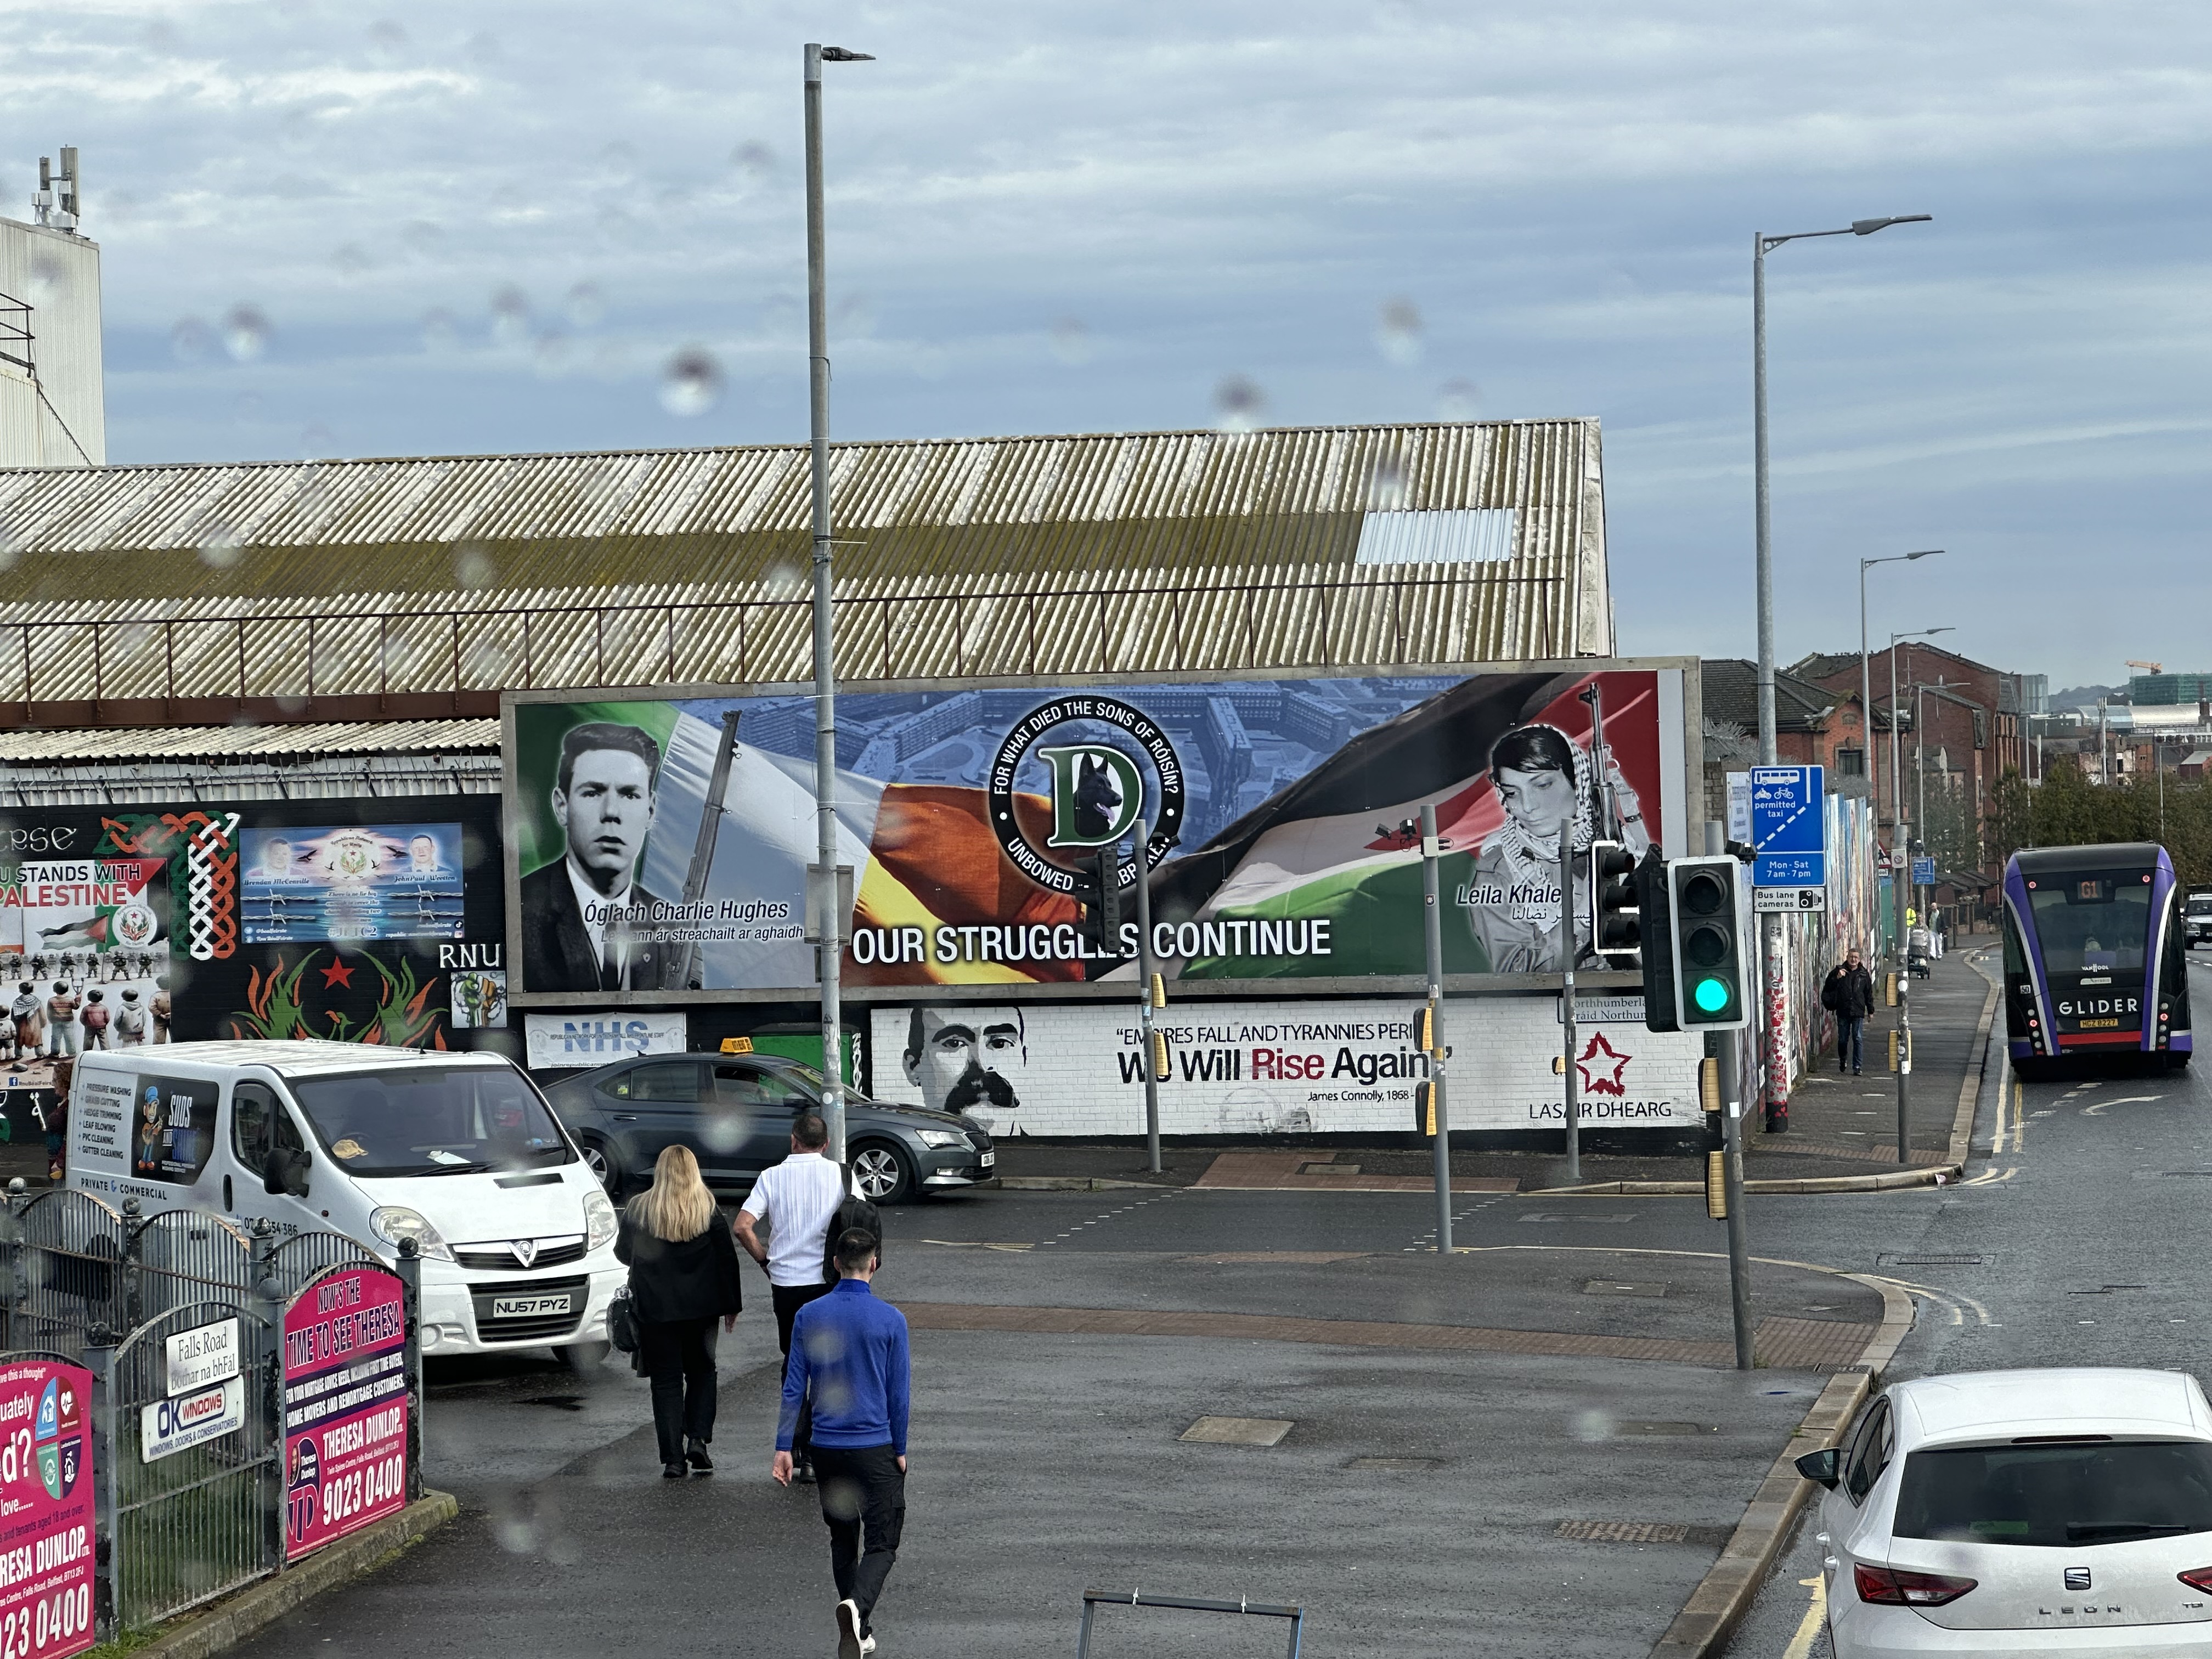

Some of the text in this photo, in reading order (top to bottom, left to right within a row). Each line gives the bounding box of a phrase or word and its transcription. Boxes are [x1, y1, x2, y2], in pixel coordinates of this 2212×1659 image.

[994, 701, 1180, 794] FOR WHAT DIED THE SONS OF RÓISÍN?
[1755, 801, 1796, 810] permitted
[18, 865, 140, 883] STANDS WITH
[1008, 837, 1074, 890] UNBOWED
[1457, 884, 1562, 905] Leila Khale
[584, 899, 788, 926] Óglach Charlie Hughes
[656, 925, 803, 944] ár streachailt ar aghaidh
[852, 927, 925, 964] OUR
[1153, 919, 1331, 957] CONTINUE
[439, 944, 500, 968] RNU
[1576, 1010, 1597, 1020] ráid
[2059, 998, 2137, 1015] GLIDER
[565, 1020, 650, 1052] NHS
[1198, 1024, 1375, 1043] FALL AND TYRANNIES
[1180, 1048, 1325, 1082] Will Rise
[110, 1086, 131, 1096] WASHING
[1308, 1090, 1408, 1103] James Connolly, 1868
[84, 1108, 99, 1118] HEDGE
[168, 1094, 193, 1128] SUDS
[1597, 1102, 1672, 1118] DHEARG
[82, 1133, 114, 1145] PVC CLEANING
[83, 1120, 116, 1133] LEAF BLOWING
[82, 1145, 123, 1159] GUTTER CLEANING
[81, 1178, 108, 1191] PRIVATE
[120, 1184, 167, 1200] COMMERCIAL
[317, 1277, 360, 1315] NOW'S THE
[496, 1298, 568, 1313] NU57 PYZ
[178, 1325, 228, 1362] Falls Road
[287, 1300, 402, 1370] TIME TO SEE THERESA
[8, 1368, 18, 1381] this
[19, 1371, 22, 1380] a
[200, 1366, 211, 1381] na
[212, 1353, 235, 1377] bhFál
[287, 1373, 405, 1428] HOME MOVERS AND REMORTGAGE CUSTOMERS.
[304, 1378, 325, 1398] MORTGAGE
[0, 1391, 33, 1422] uately
[158, 1398, 182, 1439] OK
[183, 1393, 222, 1420] WINDOWS
[175, 1432, 192, 1447] DOORS
[198, 1417, 238, 1439] CONSERVATORIES
[323, 1407, 400, 1461] THERESA DUNLOP
[301, 1454, 316, 1466] Theresa
[301, 1467, 315, 1480] Dunlop
[323, 1470, 362, 1526] 9023
[365, 1454, 402, 1508] 0400
[4, 1526, 14, 1541] and
[16, 1520, 36, 1537] tenants
[38, 1513, 51, 1531] aged
[53, 1510, 59, 1523] 18
[60, 1506, 70, 1521] and
[0, 1544, 32, 1588] RESA
[36, 1525, 86, 1574] DUNLOP
[7, 1592, 22, 1604] Centre,
[23, 1585, 33, 1598] Falls
[64, 1568, 75, 1582] BT13
[75, 1565, 84, 1577] 2FJ
[36, 1582, 88, 1650] 0400
[2039, 1602, 2121, 1615] LEON
